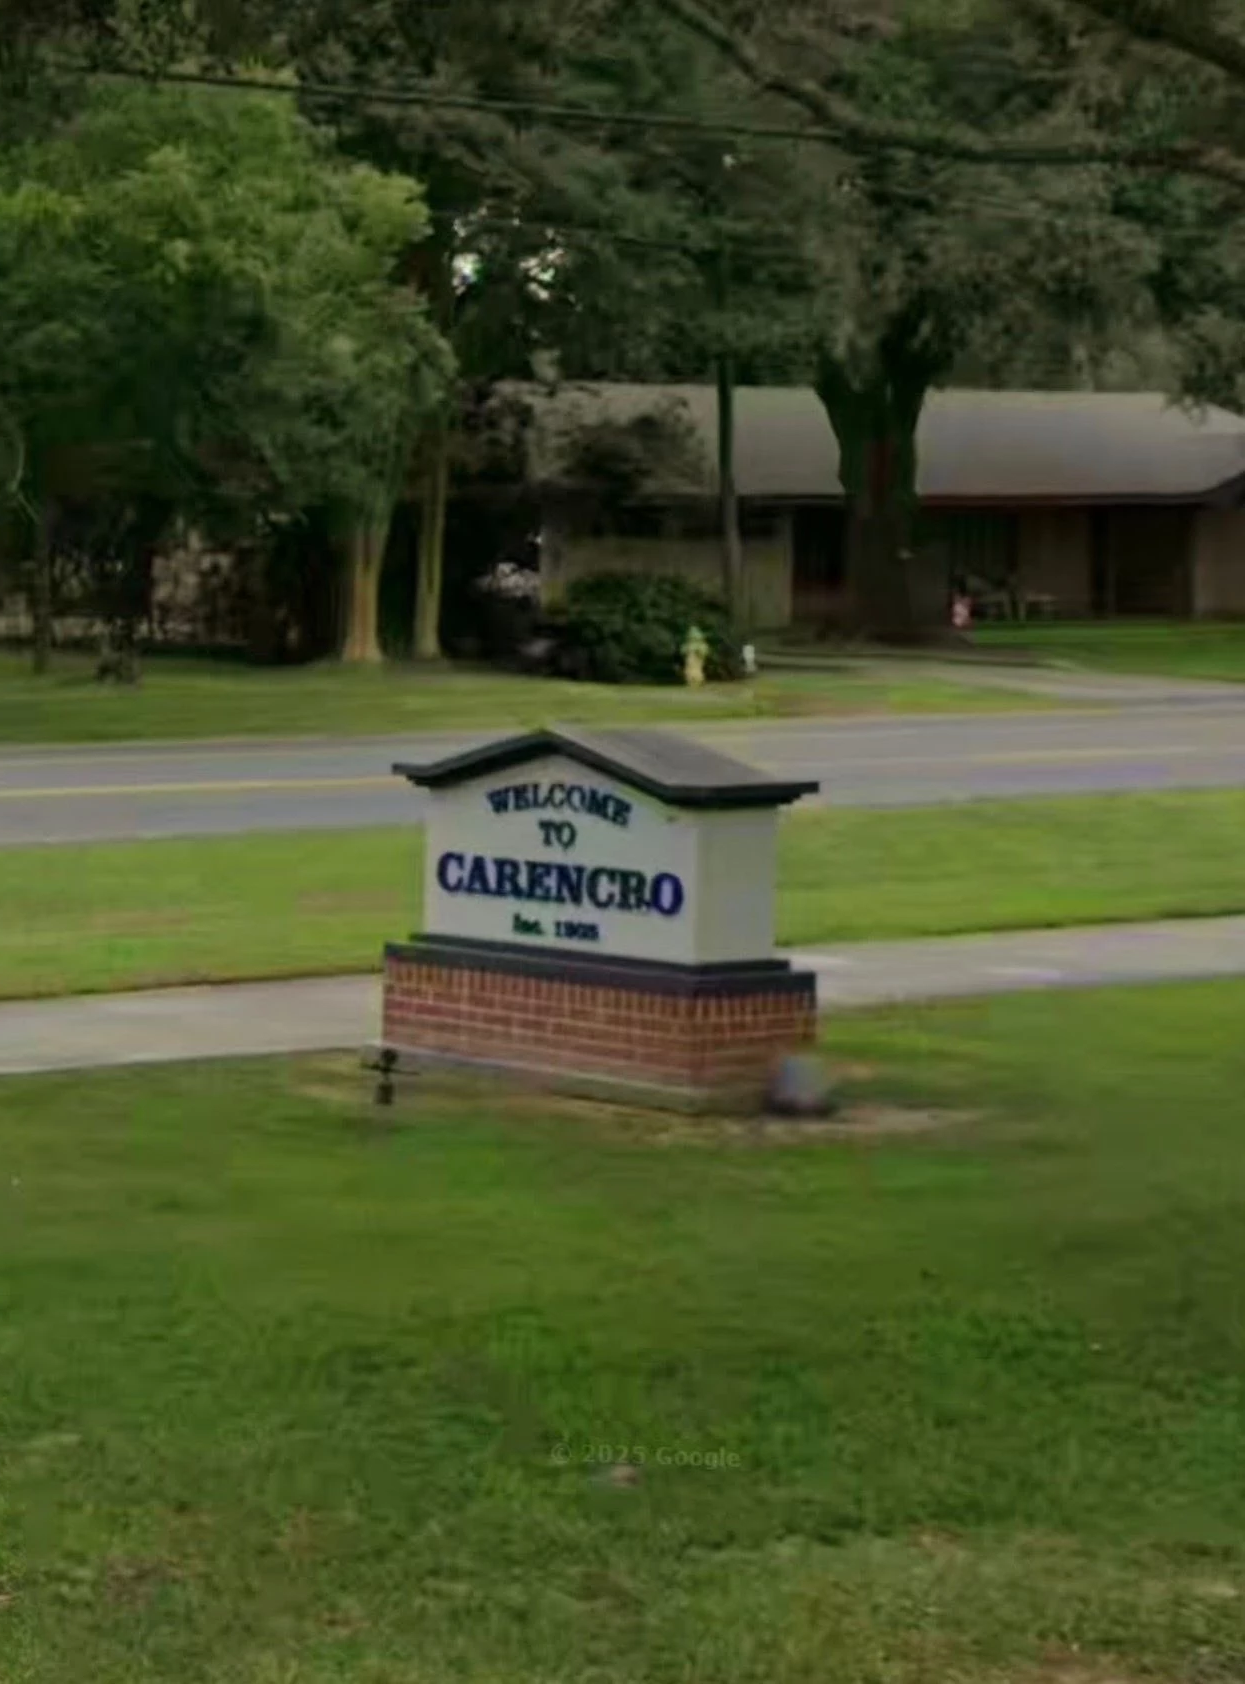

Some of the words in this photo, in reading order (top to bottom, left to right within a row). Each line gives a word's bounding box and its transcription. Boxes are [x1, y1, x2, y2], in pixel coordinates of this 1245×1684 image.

[486, 783, 632, 827] WELCOME
[539, 819, 577, 850] TO
[437, 851, 684, 916] CARENCRO
